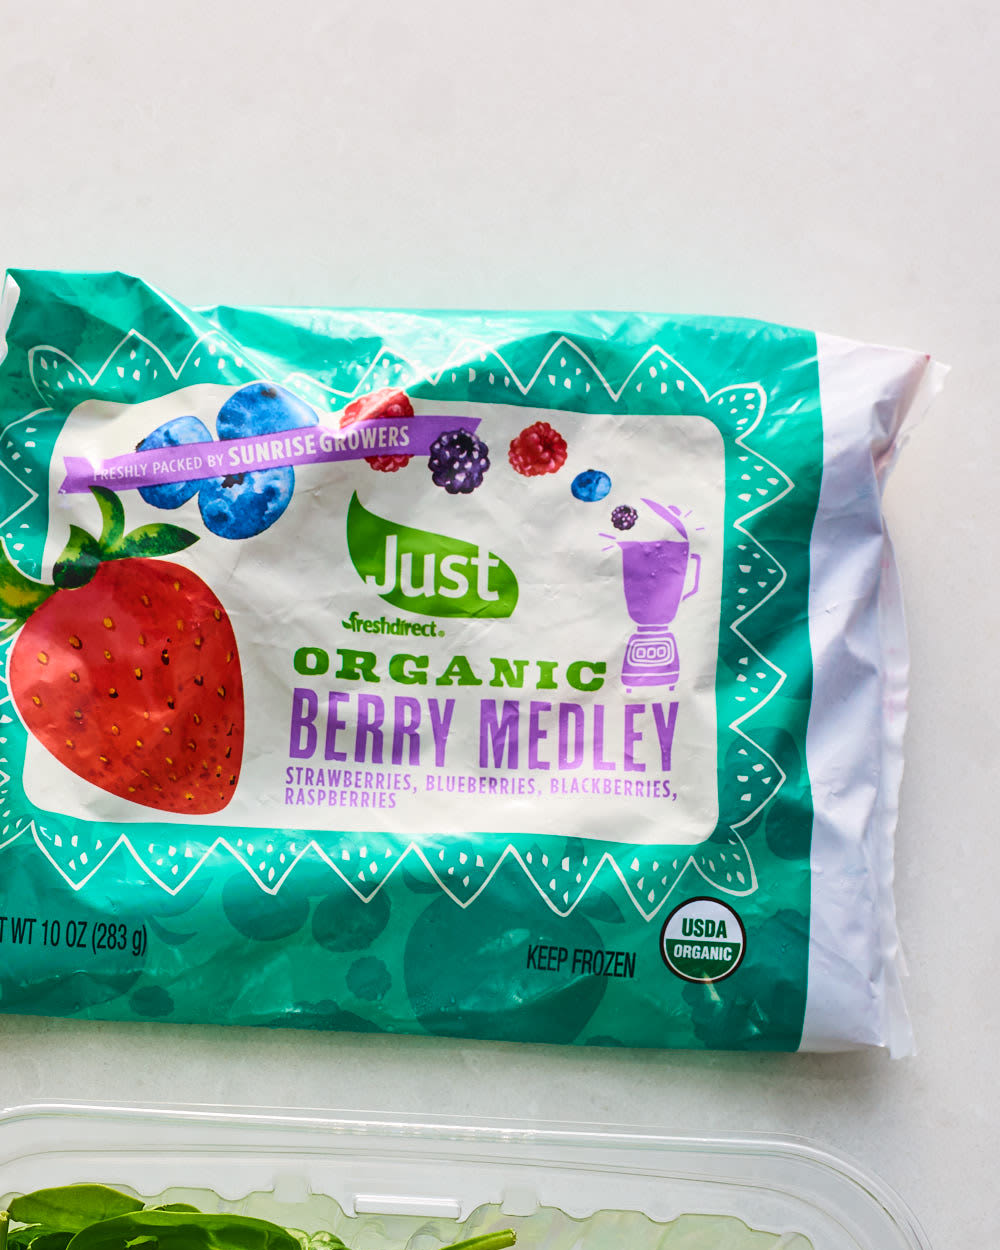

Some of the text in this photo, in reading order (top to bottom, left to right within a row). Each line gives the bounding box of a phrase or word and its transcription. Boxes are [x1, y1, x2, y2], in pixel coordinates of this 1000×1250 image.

[93, 425, 410, 482] FRESHLY PACKED BY SUNRISE GROWERS
[365, 534, 500, 601] Just
[293, 646, 607, 692] ORGANIC
[288, 687, 680, 772] BERRY MEDLEY
[285, 766, 678, 802] STRAWBERRIES, BLUEBERRIES, BLACKBERRIES,
[285, 787, 397, 809] RASPBERRIES
[11, 917, 37, 945] WT
[41, 919, 60, 947] 10
[65, 920, 88, 948] OZ
[92, 922, 127, 955] (283
[132, 924, 147, 957] g)
[681, 917, 728, 939] USDA
[526, 944, 637, 978] KEEP FROZEN
[673, 944, 733, 962] ORGANIC
